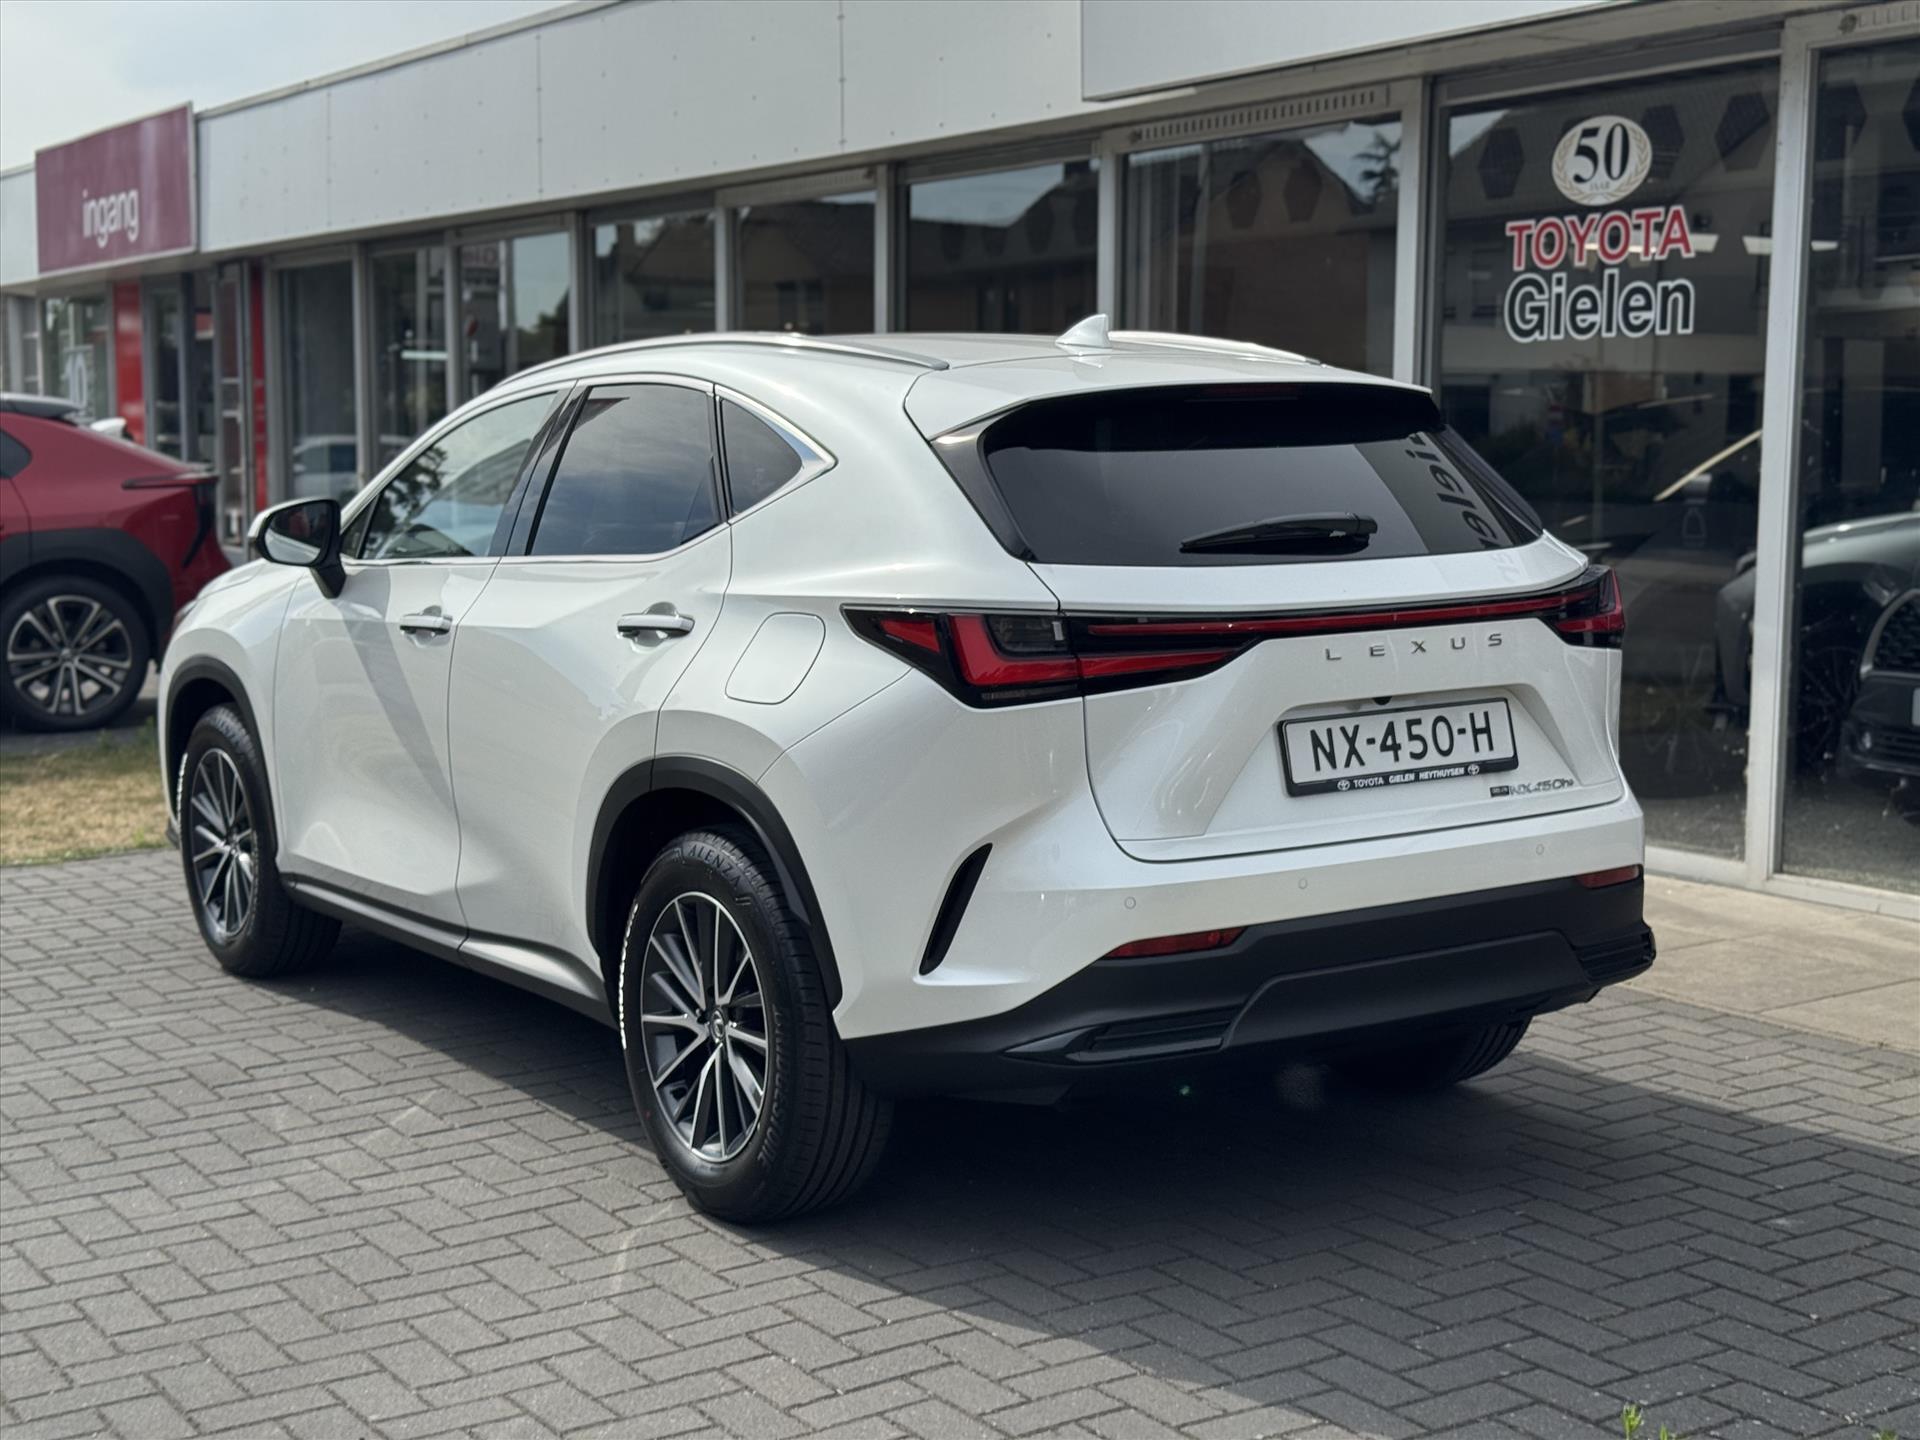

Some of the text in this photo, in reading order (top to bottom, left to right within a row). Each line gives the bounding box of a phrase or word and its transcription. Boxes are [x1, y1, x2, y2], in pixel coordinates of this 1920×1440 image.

[1573, 123, 1630, 183] 50
[83, 189, 139, 248] ingang
[1505, 205, 1696, 271] TOYOTA
[1504, 268, 1695, 343] Gielen
[1325, 633, 1502, 661] LEXUS
[1310, 711, 1494, 772] NX-450-H
[1353, 767, 1465, 788] TOYOTA GIELEN HEYTHUYSEN
[688, 844, 742, 888] ALENZA
